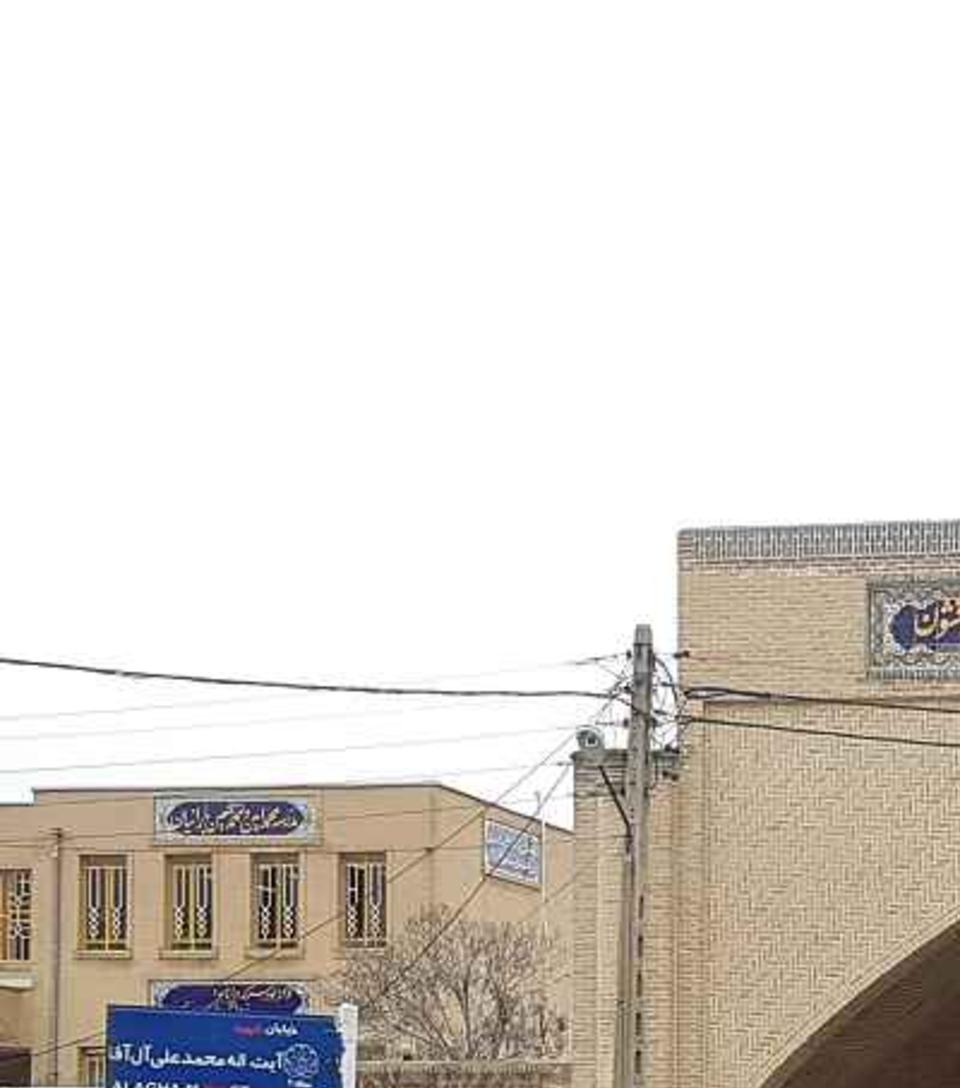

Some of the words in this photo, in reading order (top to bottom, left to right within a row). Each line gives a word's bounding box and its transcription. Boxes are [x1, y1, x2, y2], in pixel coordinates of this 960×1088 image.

[150, 1046, 182, 1069] علی
[182, 1052, 227, 1067] محمد
[249, 1051, 284, 1072] آیت
